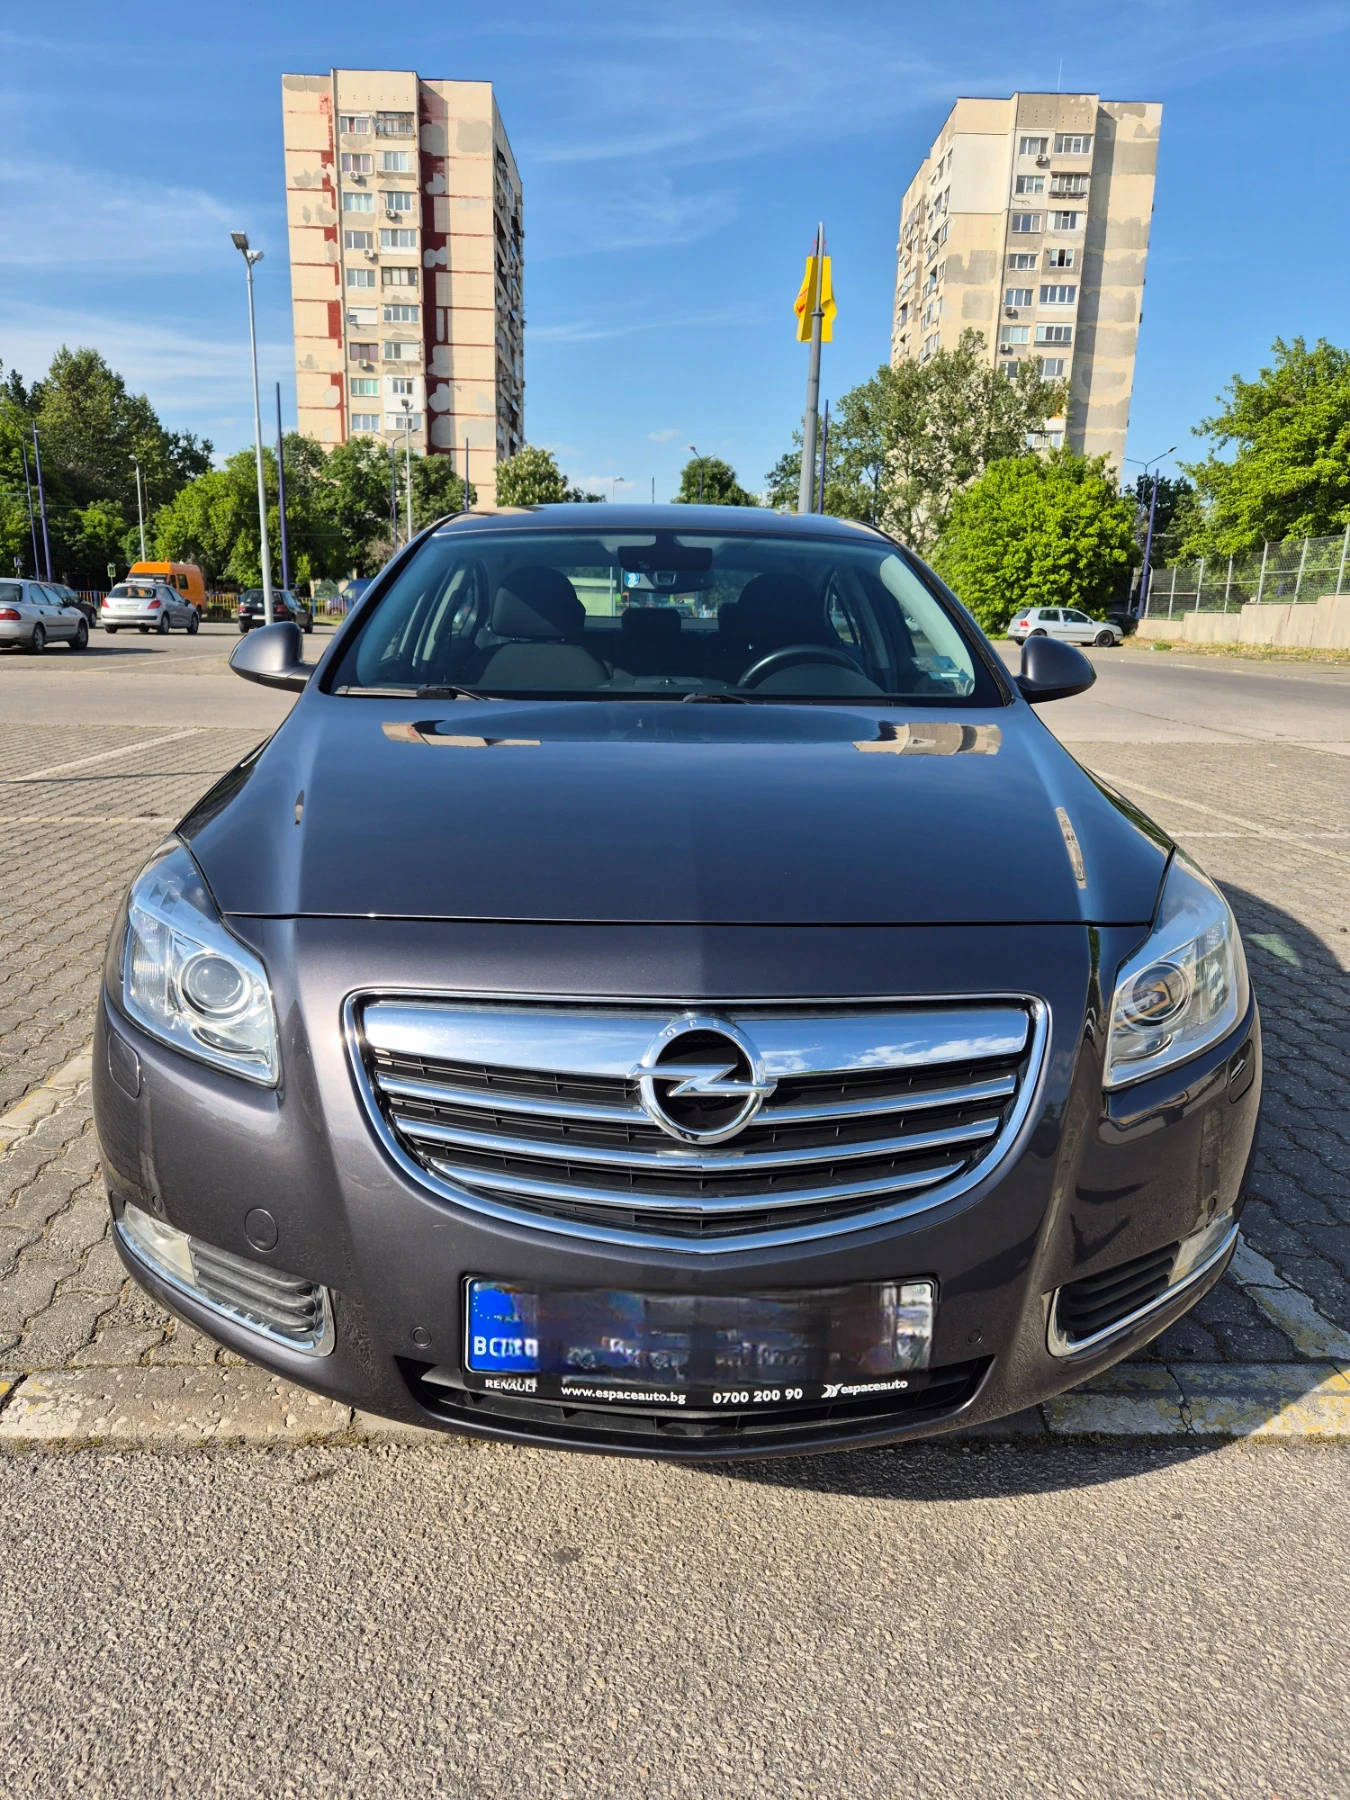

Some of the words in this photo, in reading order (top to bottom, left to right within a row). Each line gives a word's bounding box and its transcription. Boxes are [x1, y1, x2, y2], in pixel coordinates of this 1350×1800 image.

[665, 1020, 739, 1038] OPEL
[485, 1378, 538, 1393] RENAULT
[561, 1386, 686, 1405] www.espaceauto.bg
[713, 1392, 749, 1404] 0700
[753, 1390, 780, 1402] 200
[785, 1388, 803, 1400] 90
[841, 1379, 909, 1396] espaceauto
